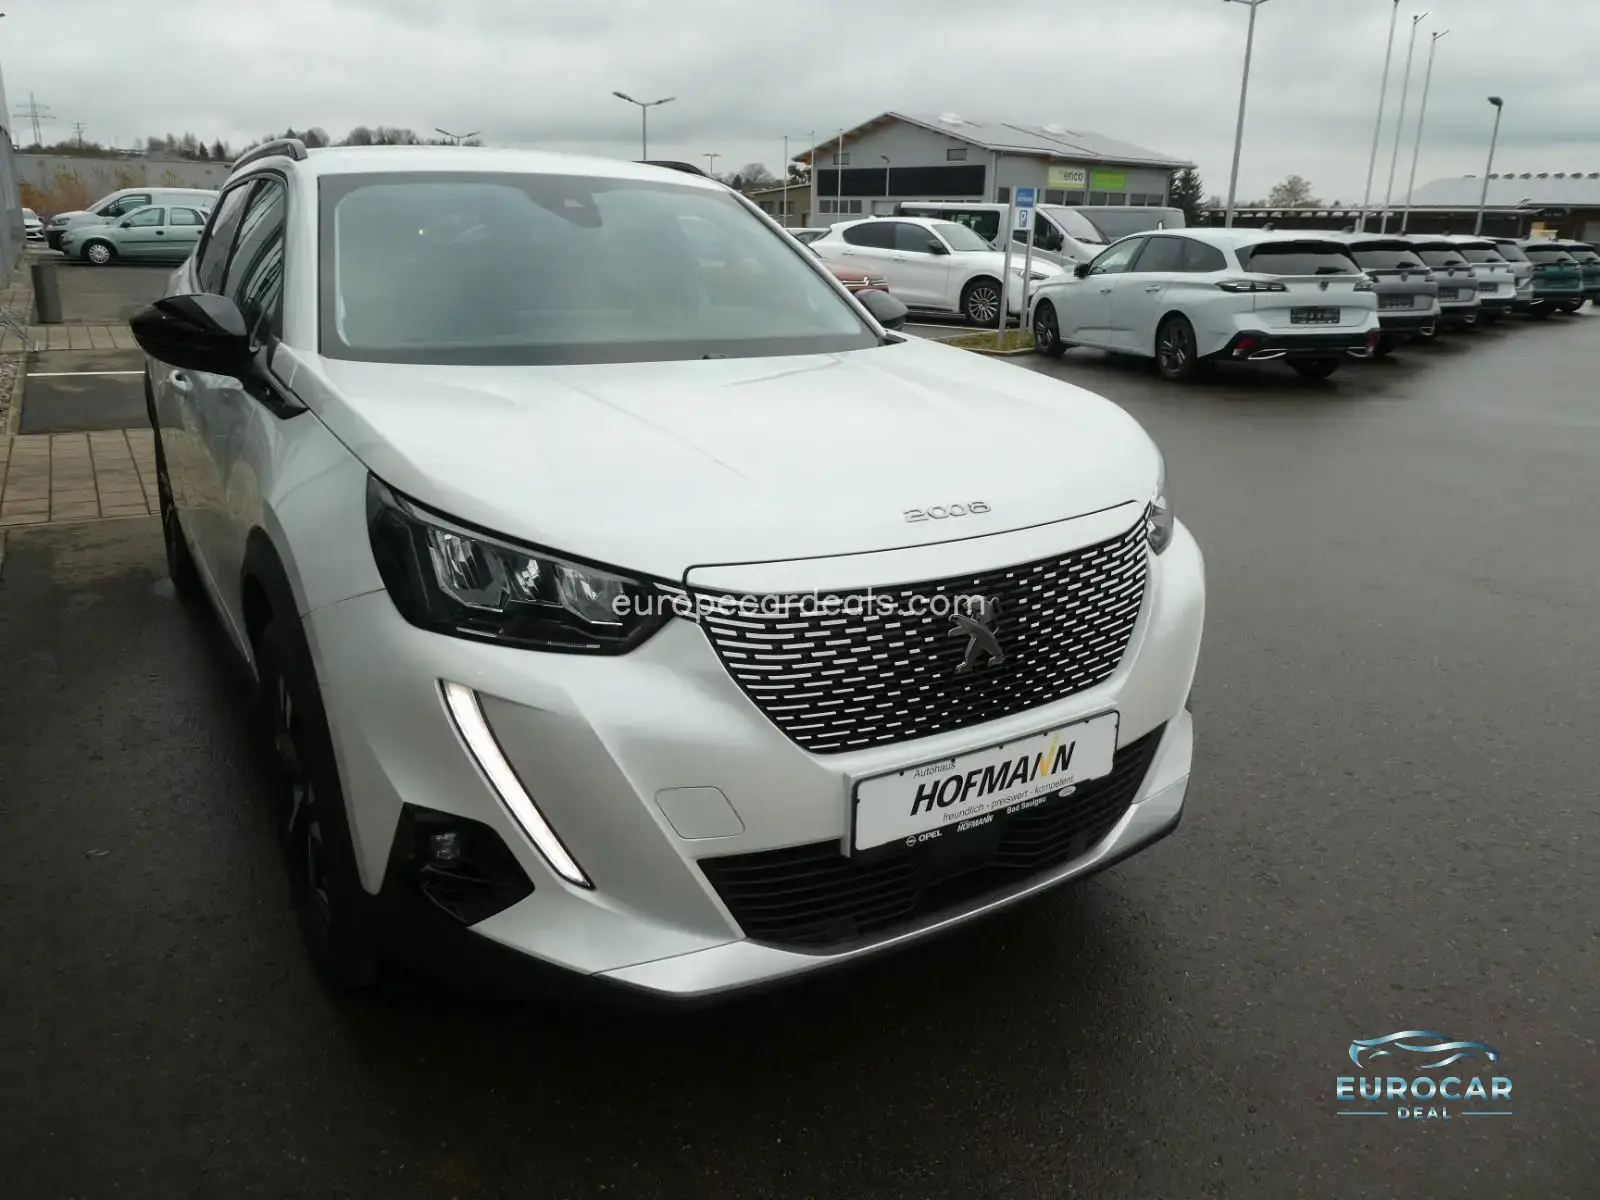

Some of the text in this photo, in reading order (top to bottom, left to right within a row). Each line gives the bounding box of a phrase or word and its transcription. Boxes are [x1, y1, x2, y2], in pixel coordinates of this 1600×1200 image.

[903, 501, 991, 523] 2008
[910, 738, 1076, 816] HOFMANN
[913, 762, 956, 779] Autohaus
[942, 804, 985, 823] freundlich
[990, 790, 1028, 809] preiswert
[1034, 776, 1074, 794] kompetent
[918, 829, 943, 842] OPEL
